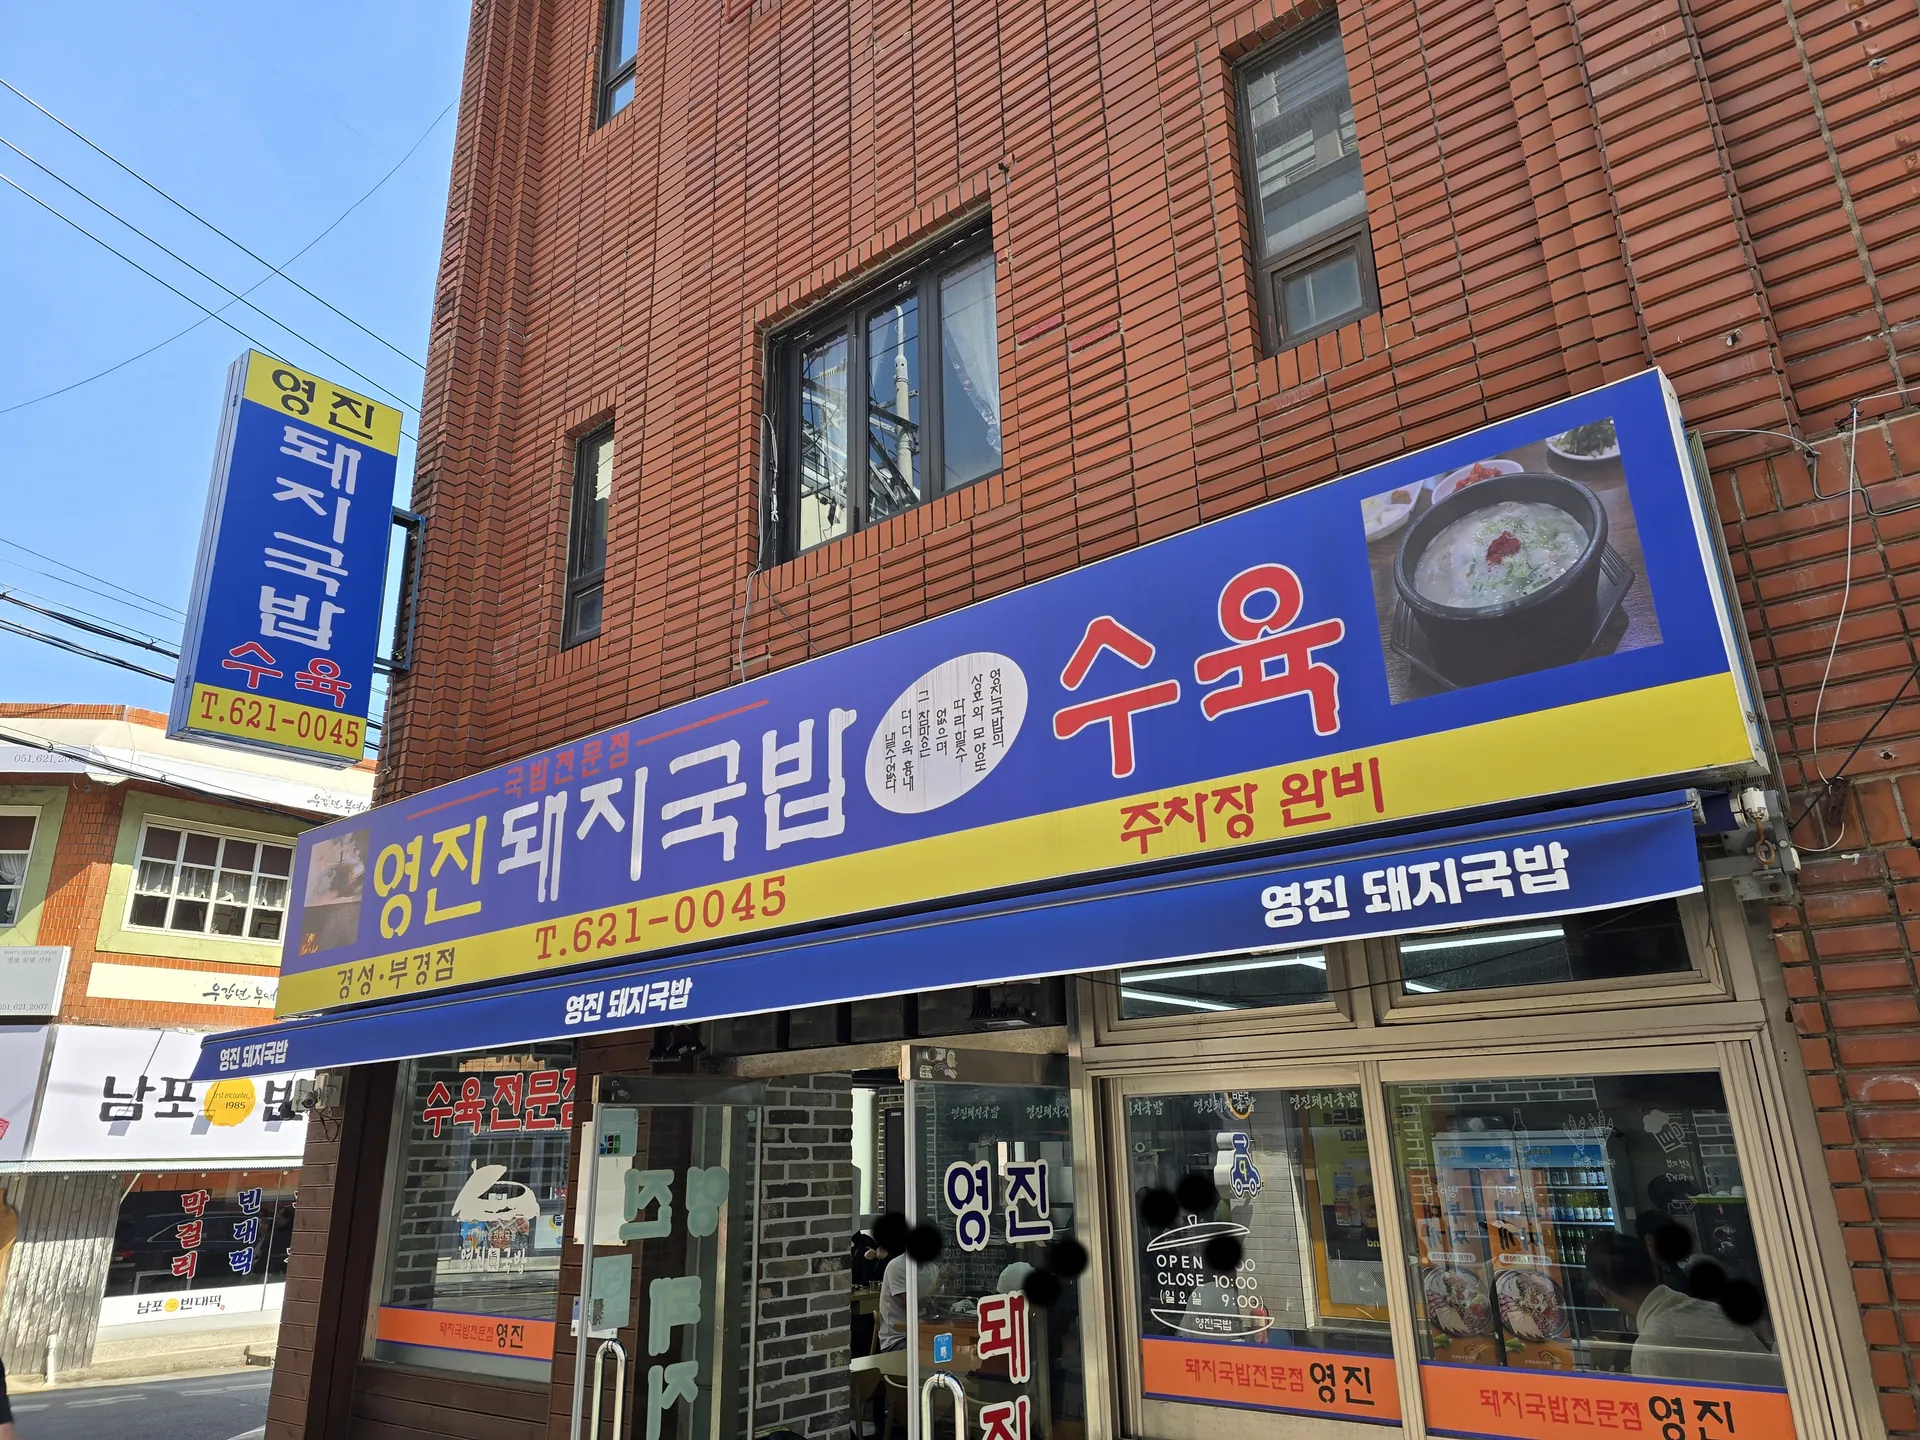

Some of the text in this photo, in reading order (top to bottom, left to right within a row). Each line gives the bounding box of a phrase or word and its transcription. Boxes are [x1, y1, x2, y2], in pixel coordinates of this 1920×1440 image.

[272, 368, 375, 440] 영진
[259, 425, 362, 651] 돼지국밥
[222, 641, 352, 709] 수육
[1052, 562, 1346, 779] 수육
[200, 690, 360, 748] T.621-0045
[936, 707, 949, 756] 없으며
[989, 668, 1005, 748] 영진국밥의
[503, 730, 631, 797] 국밥전문점
[374, 707, 857, 939] 영진 돼지국밥
[1120, 756, 1385, 855] 주차장 완비
[1260, 841, 1570, 929] 영진 돼지국밥
[535, 876, 788, 961] T.621-0045
[564, 977, 694, 1026] 영진 돼지국밥
[219, 1039, 289, 1071] 영진 돼지국밥
[99, 1075, 197, 1122] 남포
[225, 1101, 246, 1110] 1985
[1288, 1090, 1359, 1112] 영진돼지국밥
[228, 1187, 263, 1276] 빈대떡
[944, 1159, 1053, 1252] 영진
[170, 1188, 211, 1280] 막걸리
[1156, 1254, 1204, 1269] OPEN
[1157, 1272, 1258, 1290] CLOSE 10:00
[136, 1299, 164, 1315] 남포
[179, 1294, 223, 1312] 빈대떡
[1195, 1317, 1232, 1332] 영진국밥
[1221, 1294, 1264, 1311] 9:00)
[438, 1320, 525, 1350] 돼지국밥전문점 영진
[1185, 1357, 1376, 1406] 돼지국밥전문점 영진
[1479, 1389, 1643, 1432] 돼지국밥전문점
